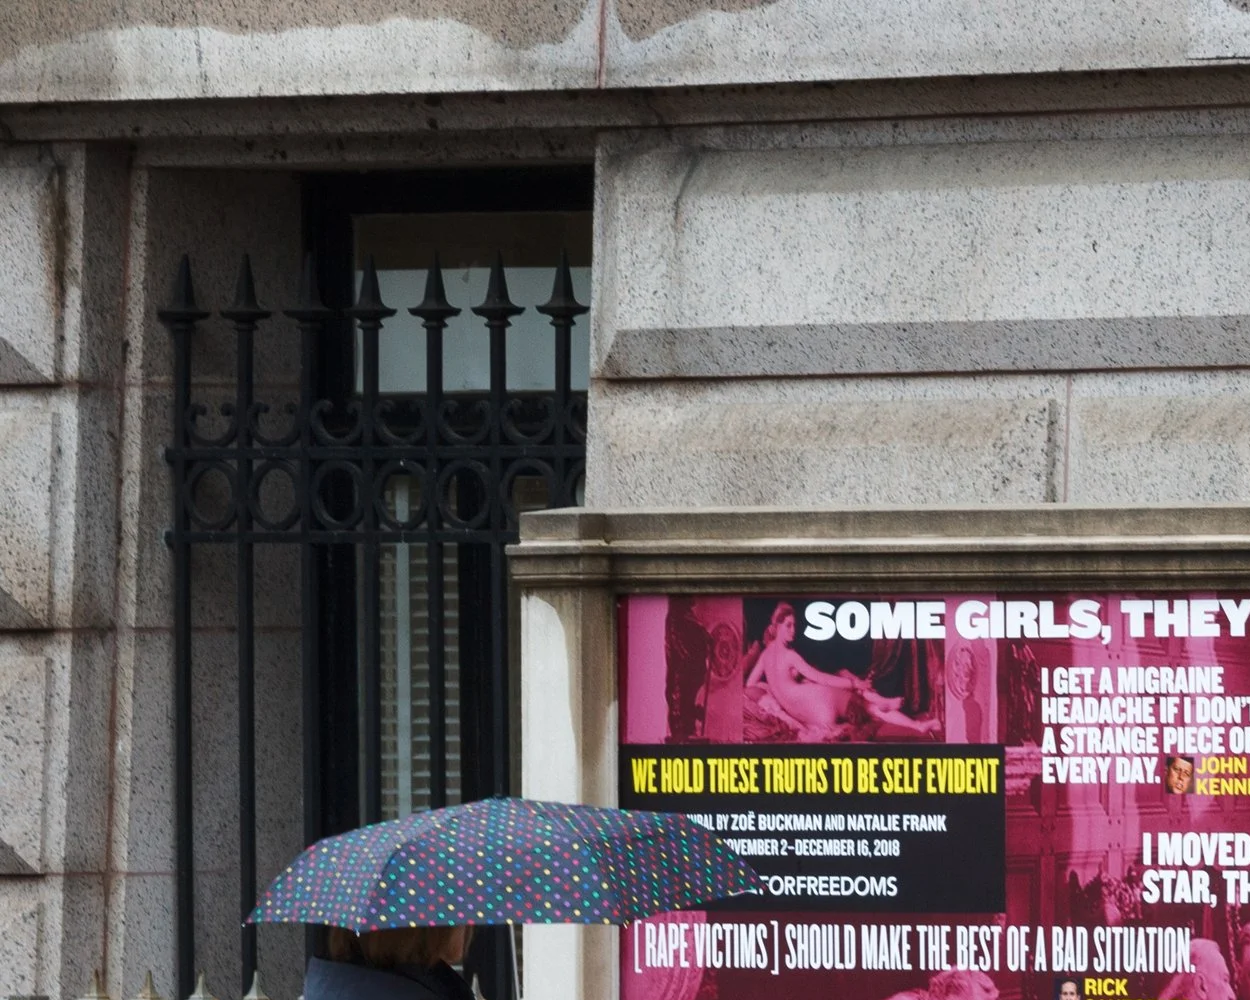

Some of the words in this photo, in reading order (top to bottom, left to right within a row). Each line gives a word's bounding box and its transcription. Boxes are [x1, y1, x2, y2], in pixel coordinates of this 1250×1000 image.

[805, 602, 946, 640] SOME
[955, 600, 1111, 642] GIRLS,
[1054, 667, 1095, 694] GET
[1099, 667, 1113, 694] A
[1118, 667, 1224, 693] MIGRAINE
[1042, 697, 1155, 724] HEADACHE
[1160, 697, 1179, 723] IF
[1041, 727, 1056, 753] A
[1061, 727, 1159, 754] STRANGE
[1164, 726, 1225, 754] PIECE
[632, 759, 657, 792] WE
[661, 759, 703, 793] HOLD
[707, 759, 759, 793] THESE
[763, 759, 827, 793] TRUTHS
[831, 758, 853, 793] TO
[858, 759, 878, 793] BE
[883, 758, 922, 793] SELF
[927, 759, 999, 793] EVIDENT
[1043, 757, 1111, 783] EVERY
[1116, 757, 1160, 783] DAY.
[1199, 757, 1247, 774] JOHN
[717, 815, 728, 830] BY
[731, 812, 755, 830] ZOË
[759, 815, 822, 830] BUCKMAN
[825, 815, 844, 830] AND
[848, 815, 900, 831] NATALIE
[903, 815, 946, 831] FRANK
[858, 840, 871, 856] 16,
[874, 840, 899, 856] 2018
[1143, 870, 1216, 906] STAR,
[786, 924, 855, 969] SHOULD
[862, 925, 912, 969] MAKE
[917, 926, 951, 970] THE
[957, 926, 1001, 971] BEST
[1007, 926, 1029, 971] OF
[1035, 927, 1046, 971] A
[1053, 927, 1087, 971] BAD
[1094, 927, 1195, 972] SITUATION.
[1085, 978, 1127, 995] RICK
